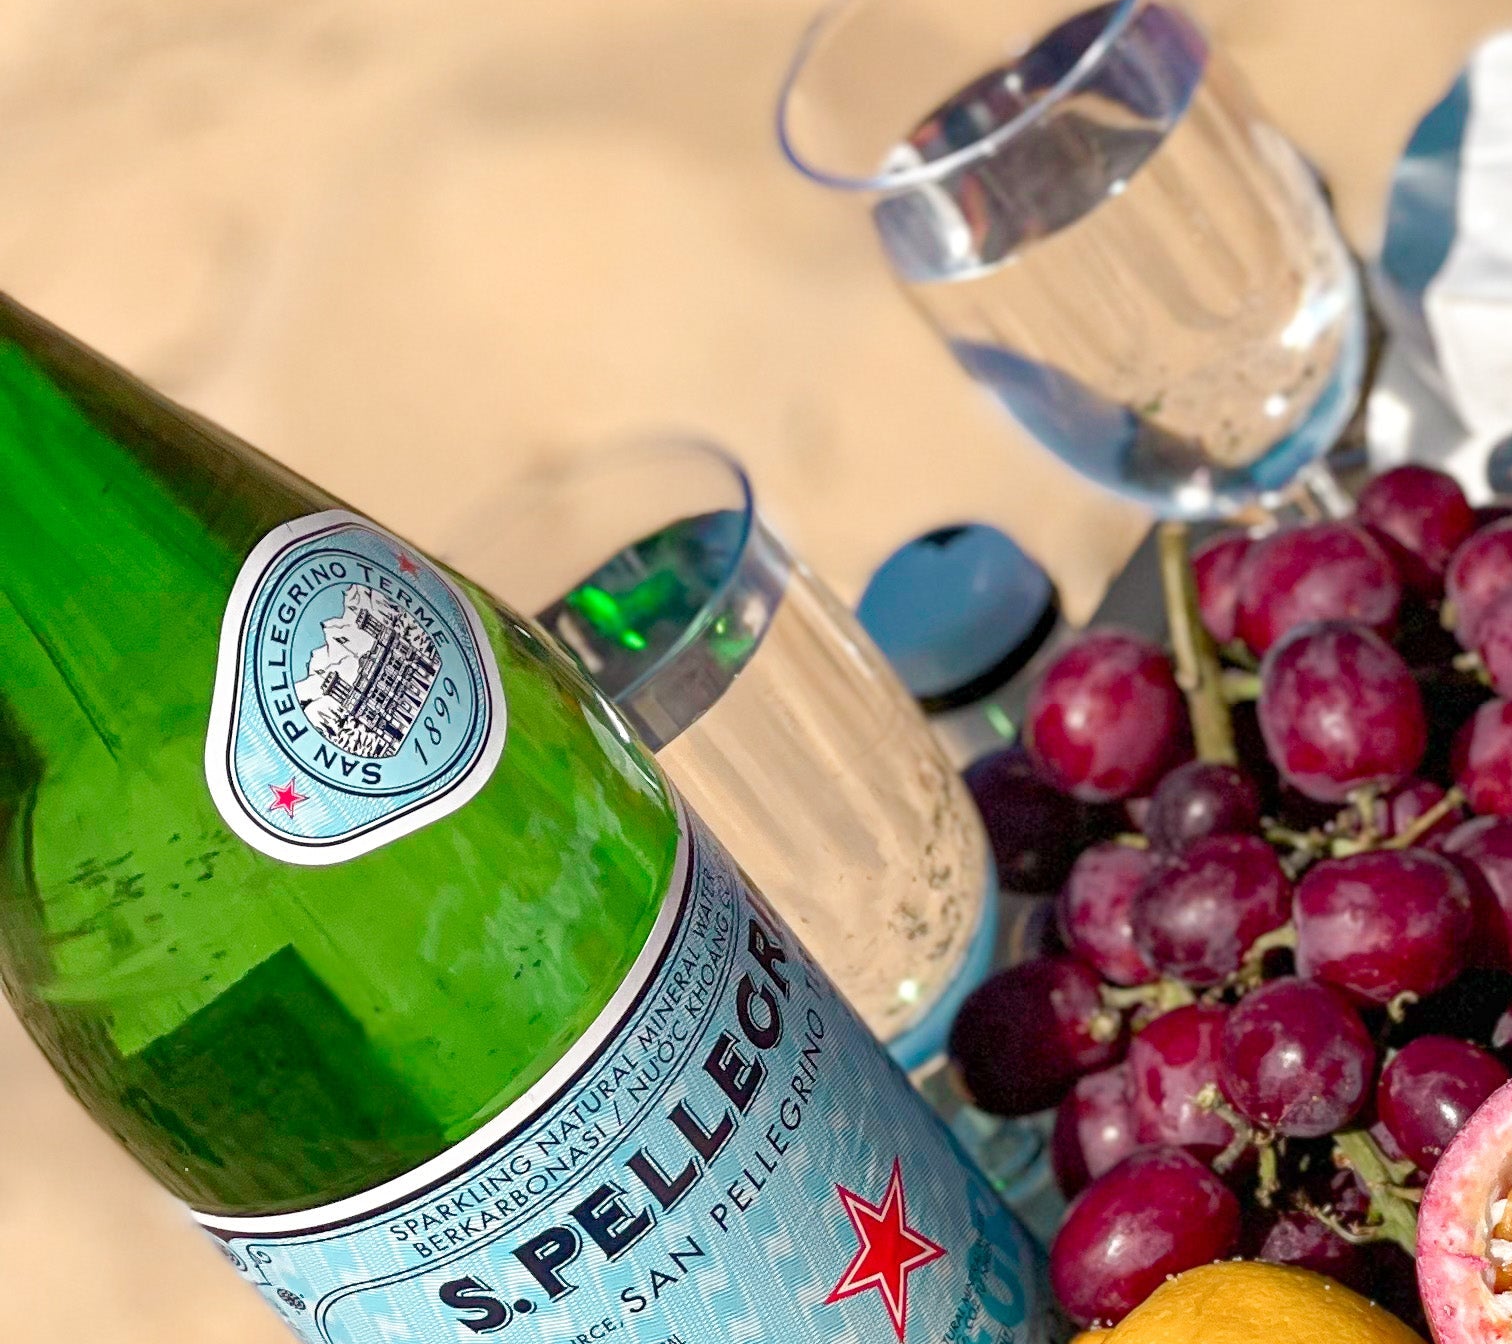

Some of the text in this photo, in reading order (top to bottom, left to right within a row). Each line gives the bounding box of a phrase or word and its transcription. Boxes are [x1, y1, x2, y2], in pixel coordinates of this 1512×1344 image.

[268, 561, 450, 785] SAN PELLEGRINO TERME
[413, 676, 461, 765] 1899
[389, 867, 716, 1242] SPARKLING NATURAL MINERAL WATER
[618, 1235, 707, 1318] SAN
[709, 1007, 826, 1234] PELLEGRINO
[412, 1121, 608, 1259] BERKARBONASI
